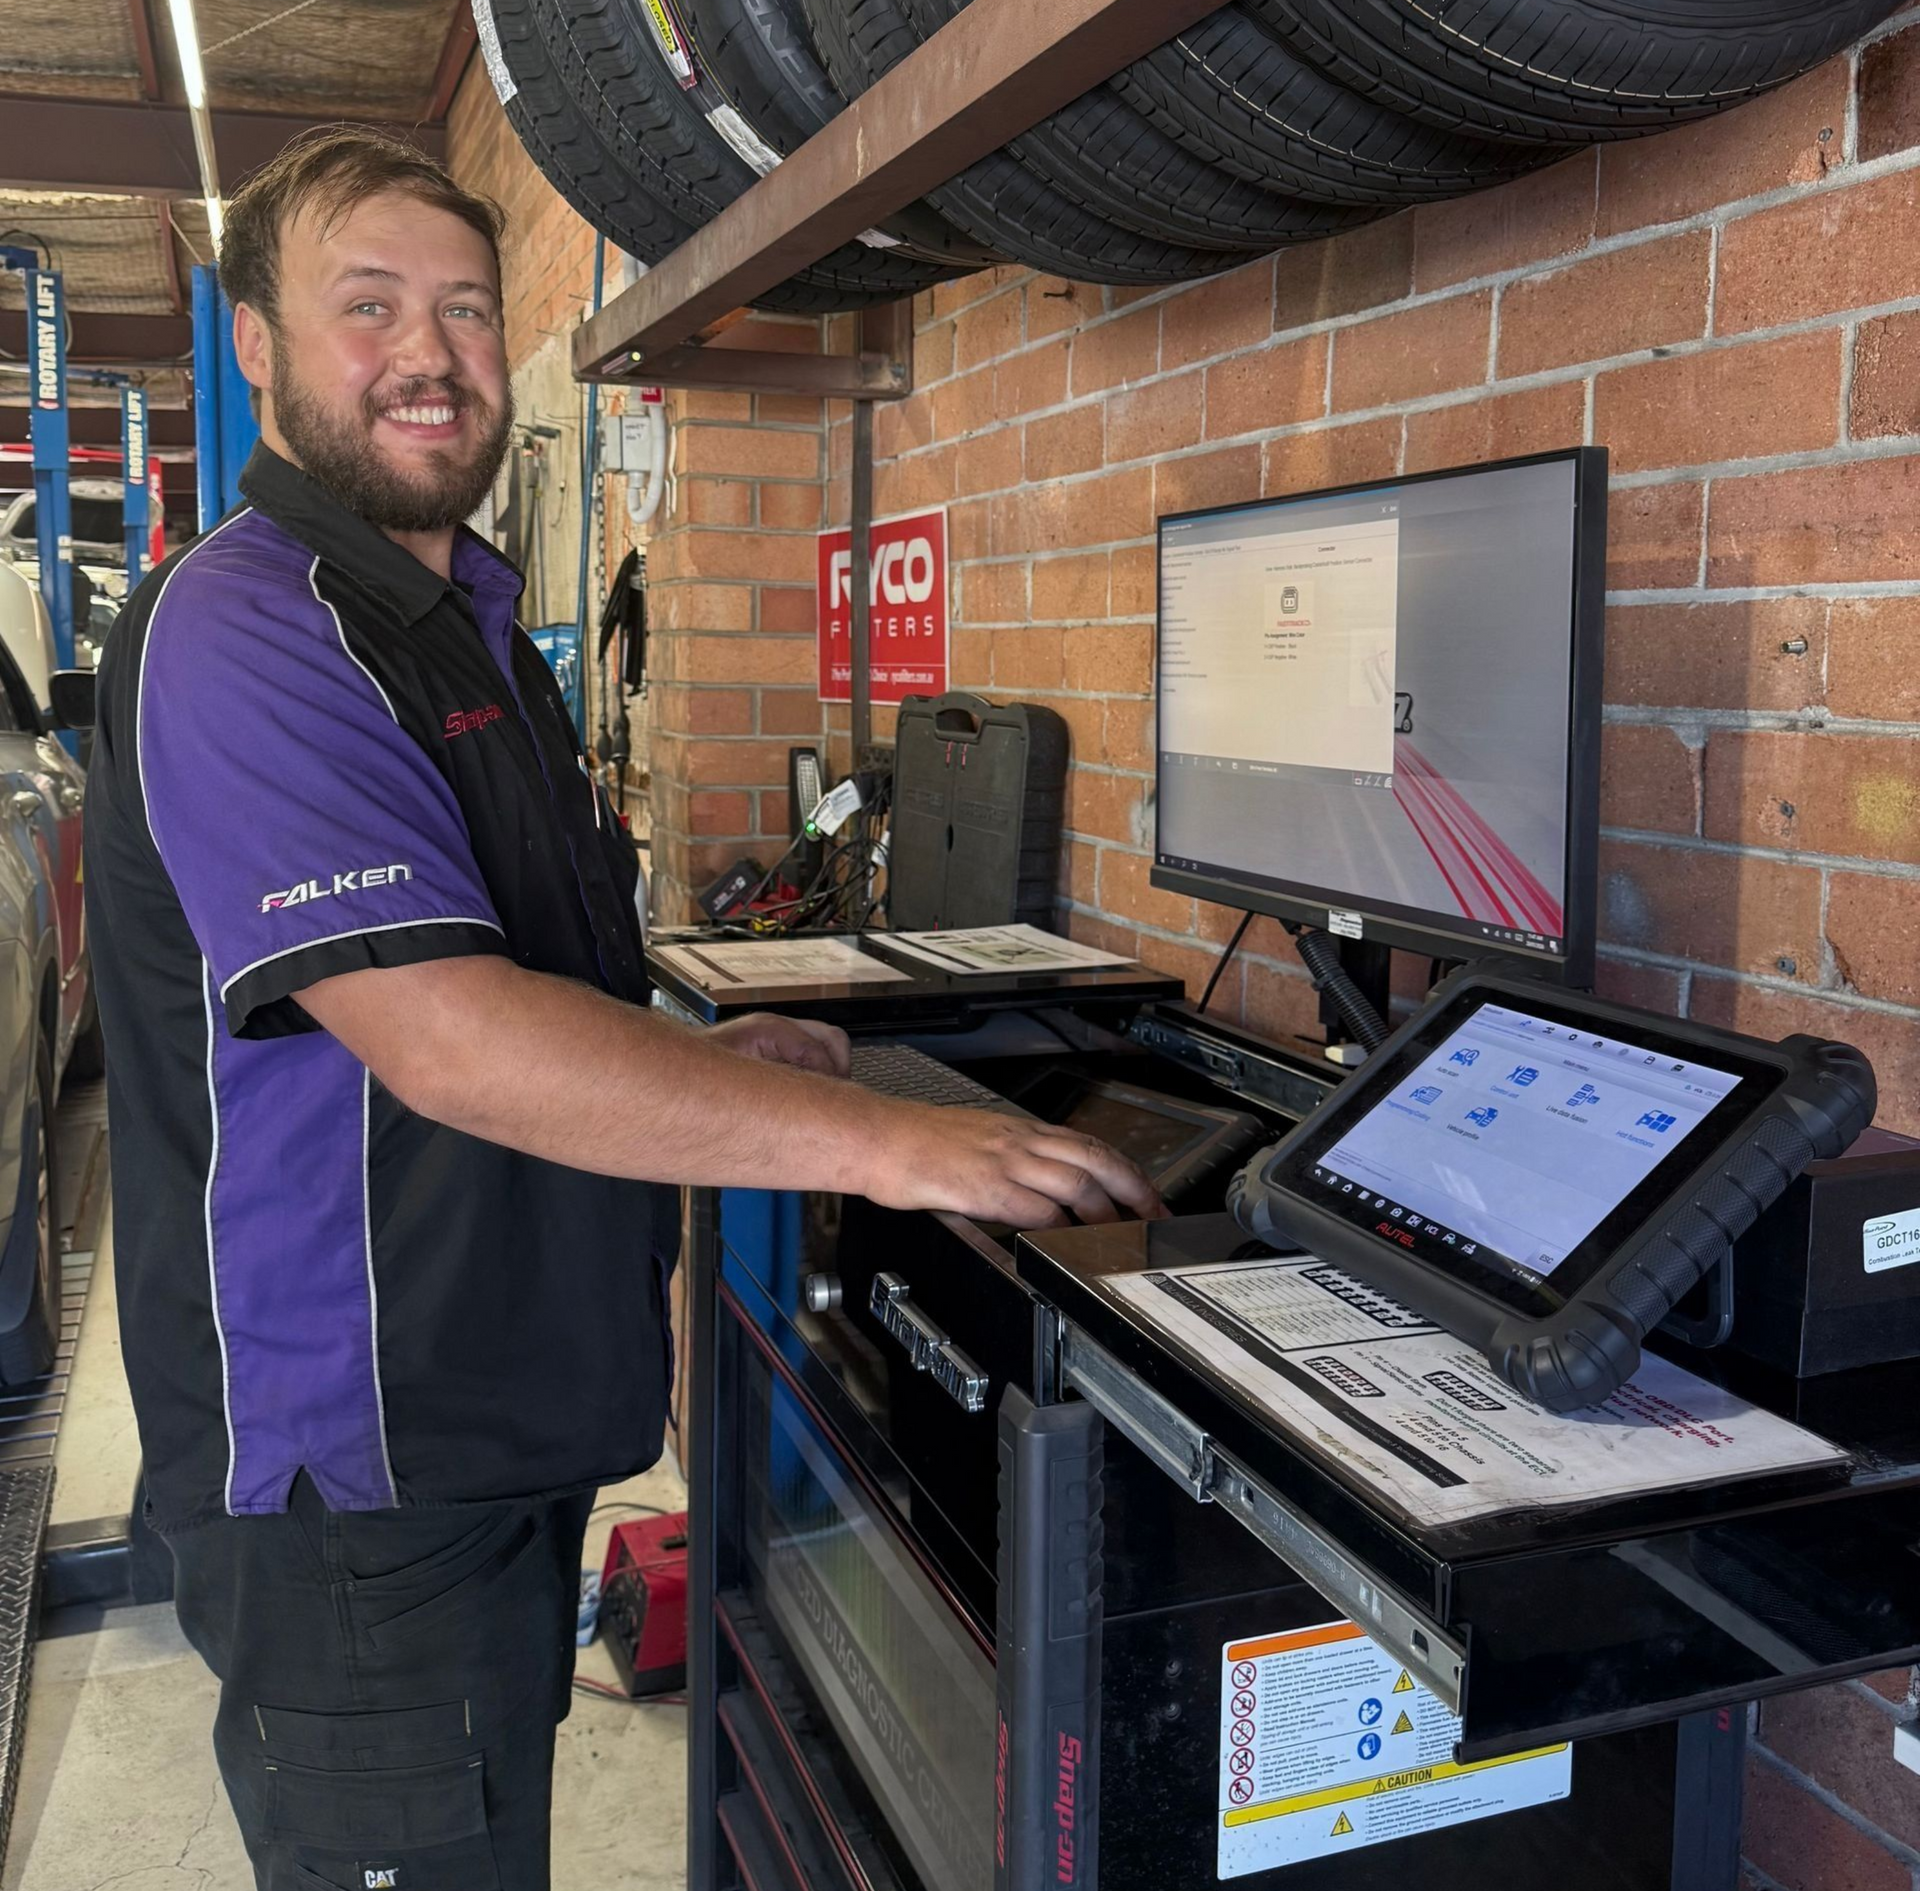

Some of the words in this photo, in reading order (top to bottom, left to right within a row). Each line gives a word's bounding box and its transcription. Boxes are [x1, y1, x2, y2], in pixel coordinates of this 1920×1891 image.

[36, 275, 55, 318] LIFT
[38, 321, 57, 400] ROTARY
[128, 391, 143, 422] LIFT
[128, 422, 144, 478] ROTARY
[830, 537, 934, 609] RYCO
[830, 615, 934, 639] FITERS
[259, 864, 413, 913] FALKEN
[1375, 1222, 1415, 1248] AUTEL
[1877, 1228, 1920, 1249] GDCT16
[1539, 1254, 1554, 1264] ESC
[1868, 1253, 1901, 1265] Combustion
[1422, 1415, 1443, 1427] Pins
[1623, 1382, 1644, 1394] the
[1703, 1424, 1734, 1444] Port.
[1629, 1407, 1683, 1438] network.
[1401, 1424, 1422, 1434] and
[1414, 1422, 1435, 1432] and
[1448, 1441, 1486, 1465] Chassis
[1477, 1422, 1498, 1434] there
[1495, 1433, 1510, 1442] are
[1508, 1441, 1525, 1452] two
[1661, 1413, 1720, 1448] charging,
[1514, 1454, 1530, 1465] the
[1387, 1768, 1433, 1788] CAUTION
[1054, 1730, 1082, 1884] Snap-on
[364, 1869, 397, 1889] CAT
